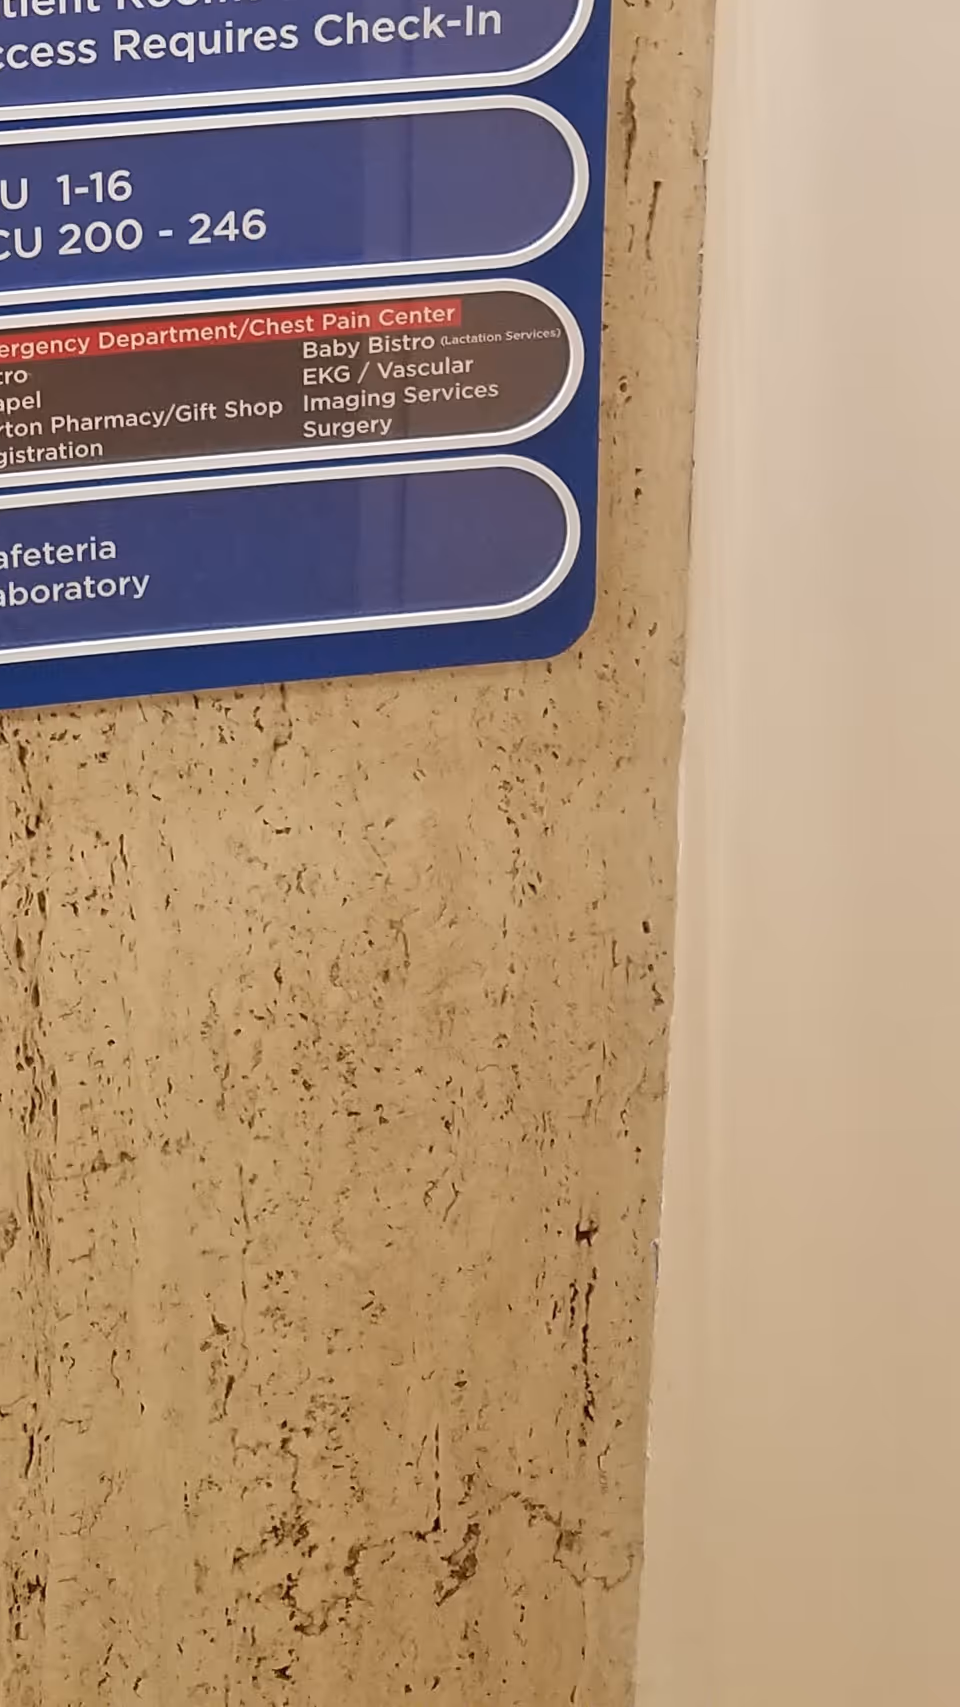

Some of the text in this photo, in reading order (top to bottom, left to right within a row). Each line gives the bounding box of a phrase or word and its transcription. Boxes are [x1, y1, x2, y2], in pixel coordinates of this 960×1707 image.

[114, 21, 298, 62] Requires
[315, 5, 500, 46] Check-In
[57, 170, 132, 205] 1-16
[59, 219, 142, 254] 200
[189, 209, 266, 244] 246
[99, 316, 314, 350] Department/Chest
[323, 314, 370, 330] Pain
[379, 307, 455, 326] Center
[304, 328, 561, 358] Baby Bistro (Lactation Services)
[304, 357, 473, 385] EKG / Vascular
[304, 383, 498, 411] Imaging Services
[52, 403, 216, 433] Pharmacy/Gift
[225, 400, 282, 418] Shop
[304, 419, 392, 438] Surgery
